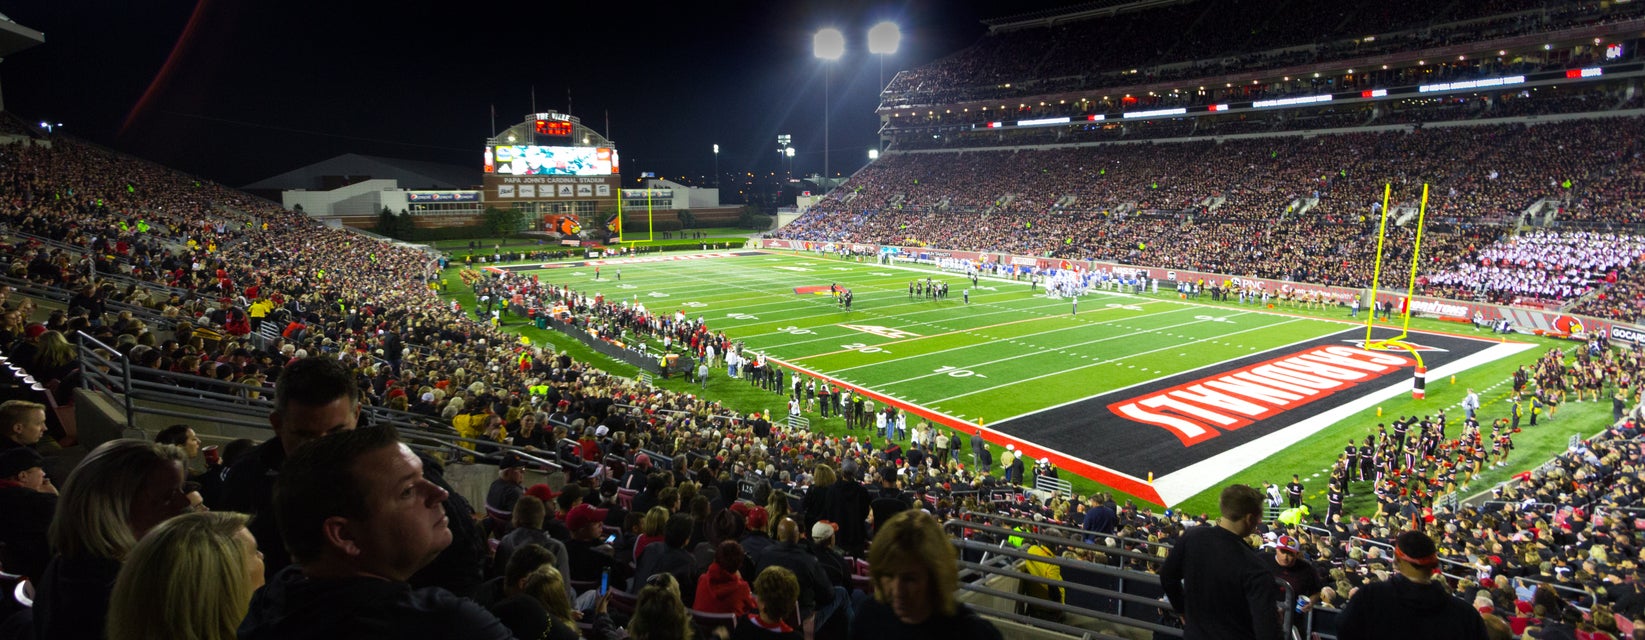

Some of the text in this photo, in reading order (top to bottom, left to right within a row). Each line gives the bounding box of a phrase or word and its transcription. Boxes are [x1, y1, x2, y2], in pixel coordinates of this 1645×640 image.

[551, 113, 570, 121] VILLE
[1242, 279, 1265, 290] PNC
[933, 365, 975, 378] 10
[1118, 346, 1407, 438] CARDINALS
[742, 483, 755, 495] 125
